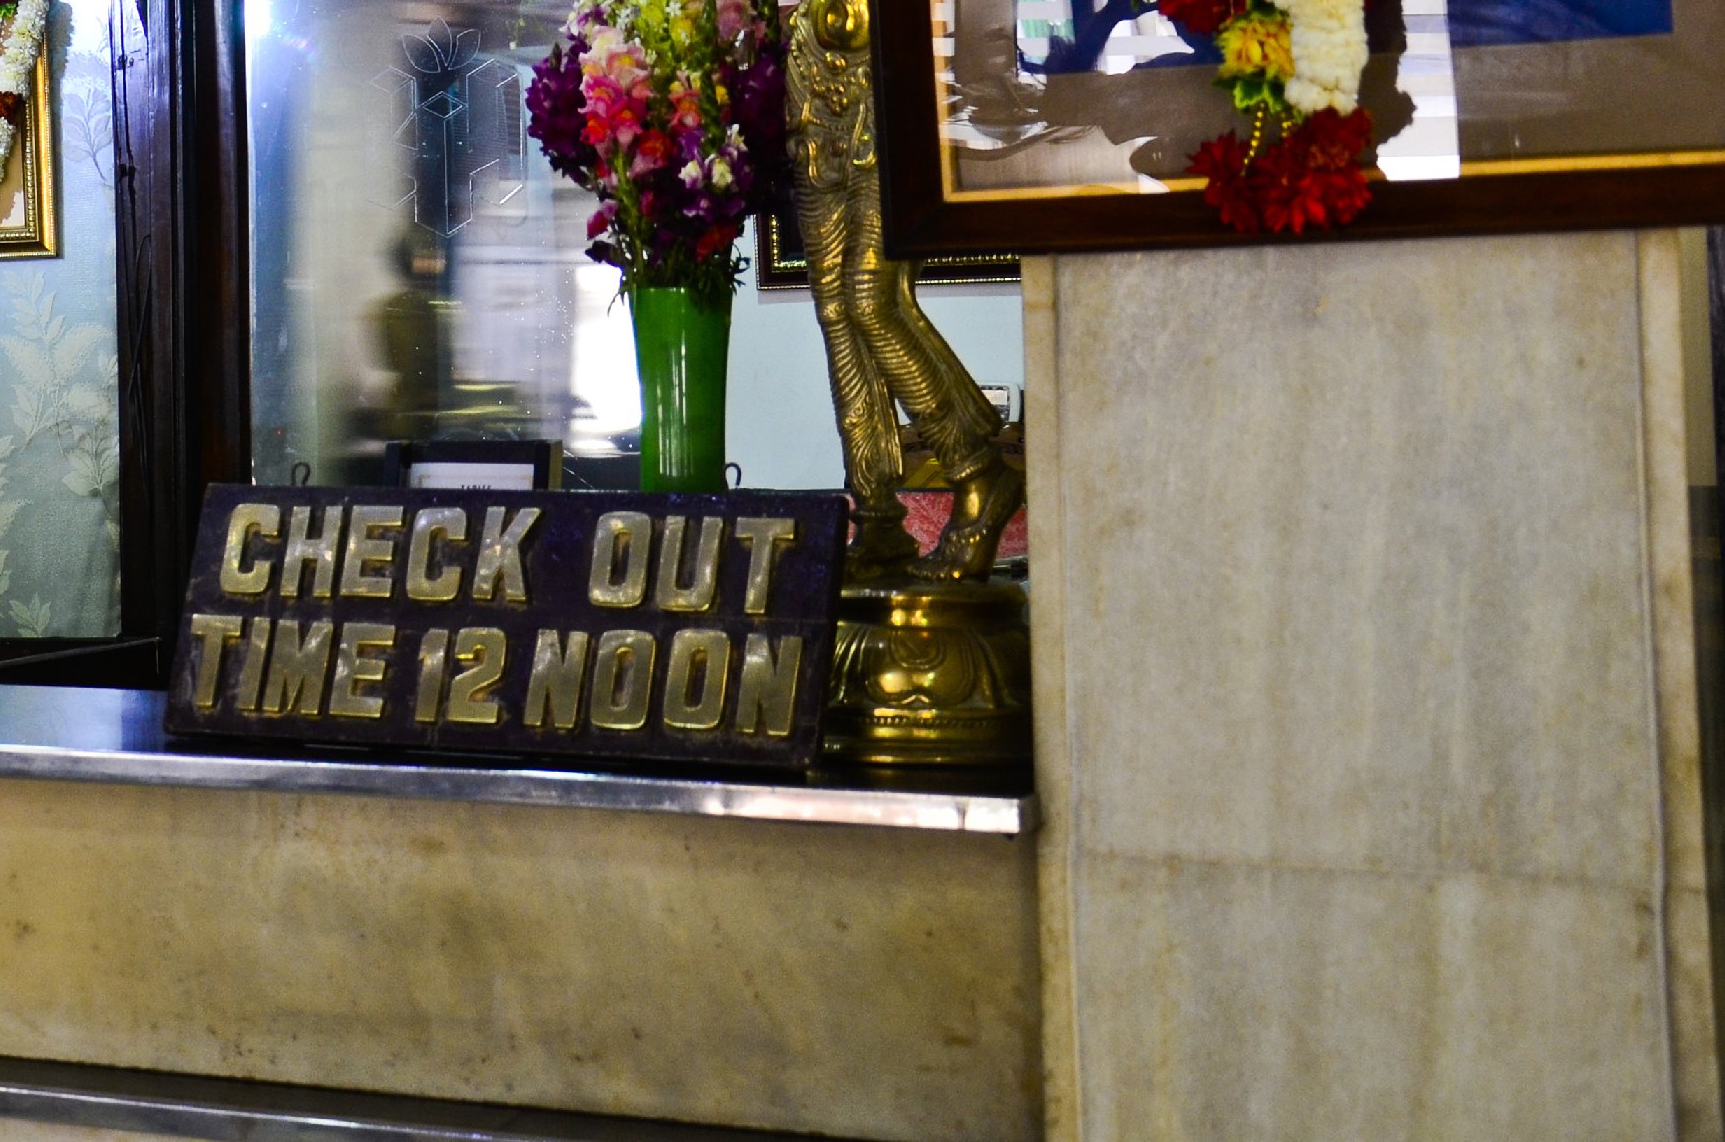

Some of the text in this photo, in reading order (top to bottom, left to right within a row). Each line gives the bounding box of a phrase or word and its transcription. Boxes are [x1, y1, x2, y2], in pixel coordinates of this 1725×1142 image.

[218, 502, 795, 615] CHECK OUT
[190, 613, 803, 737] TIME 12 NOON
